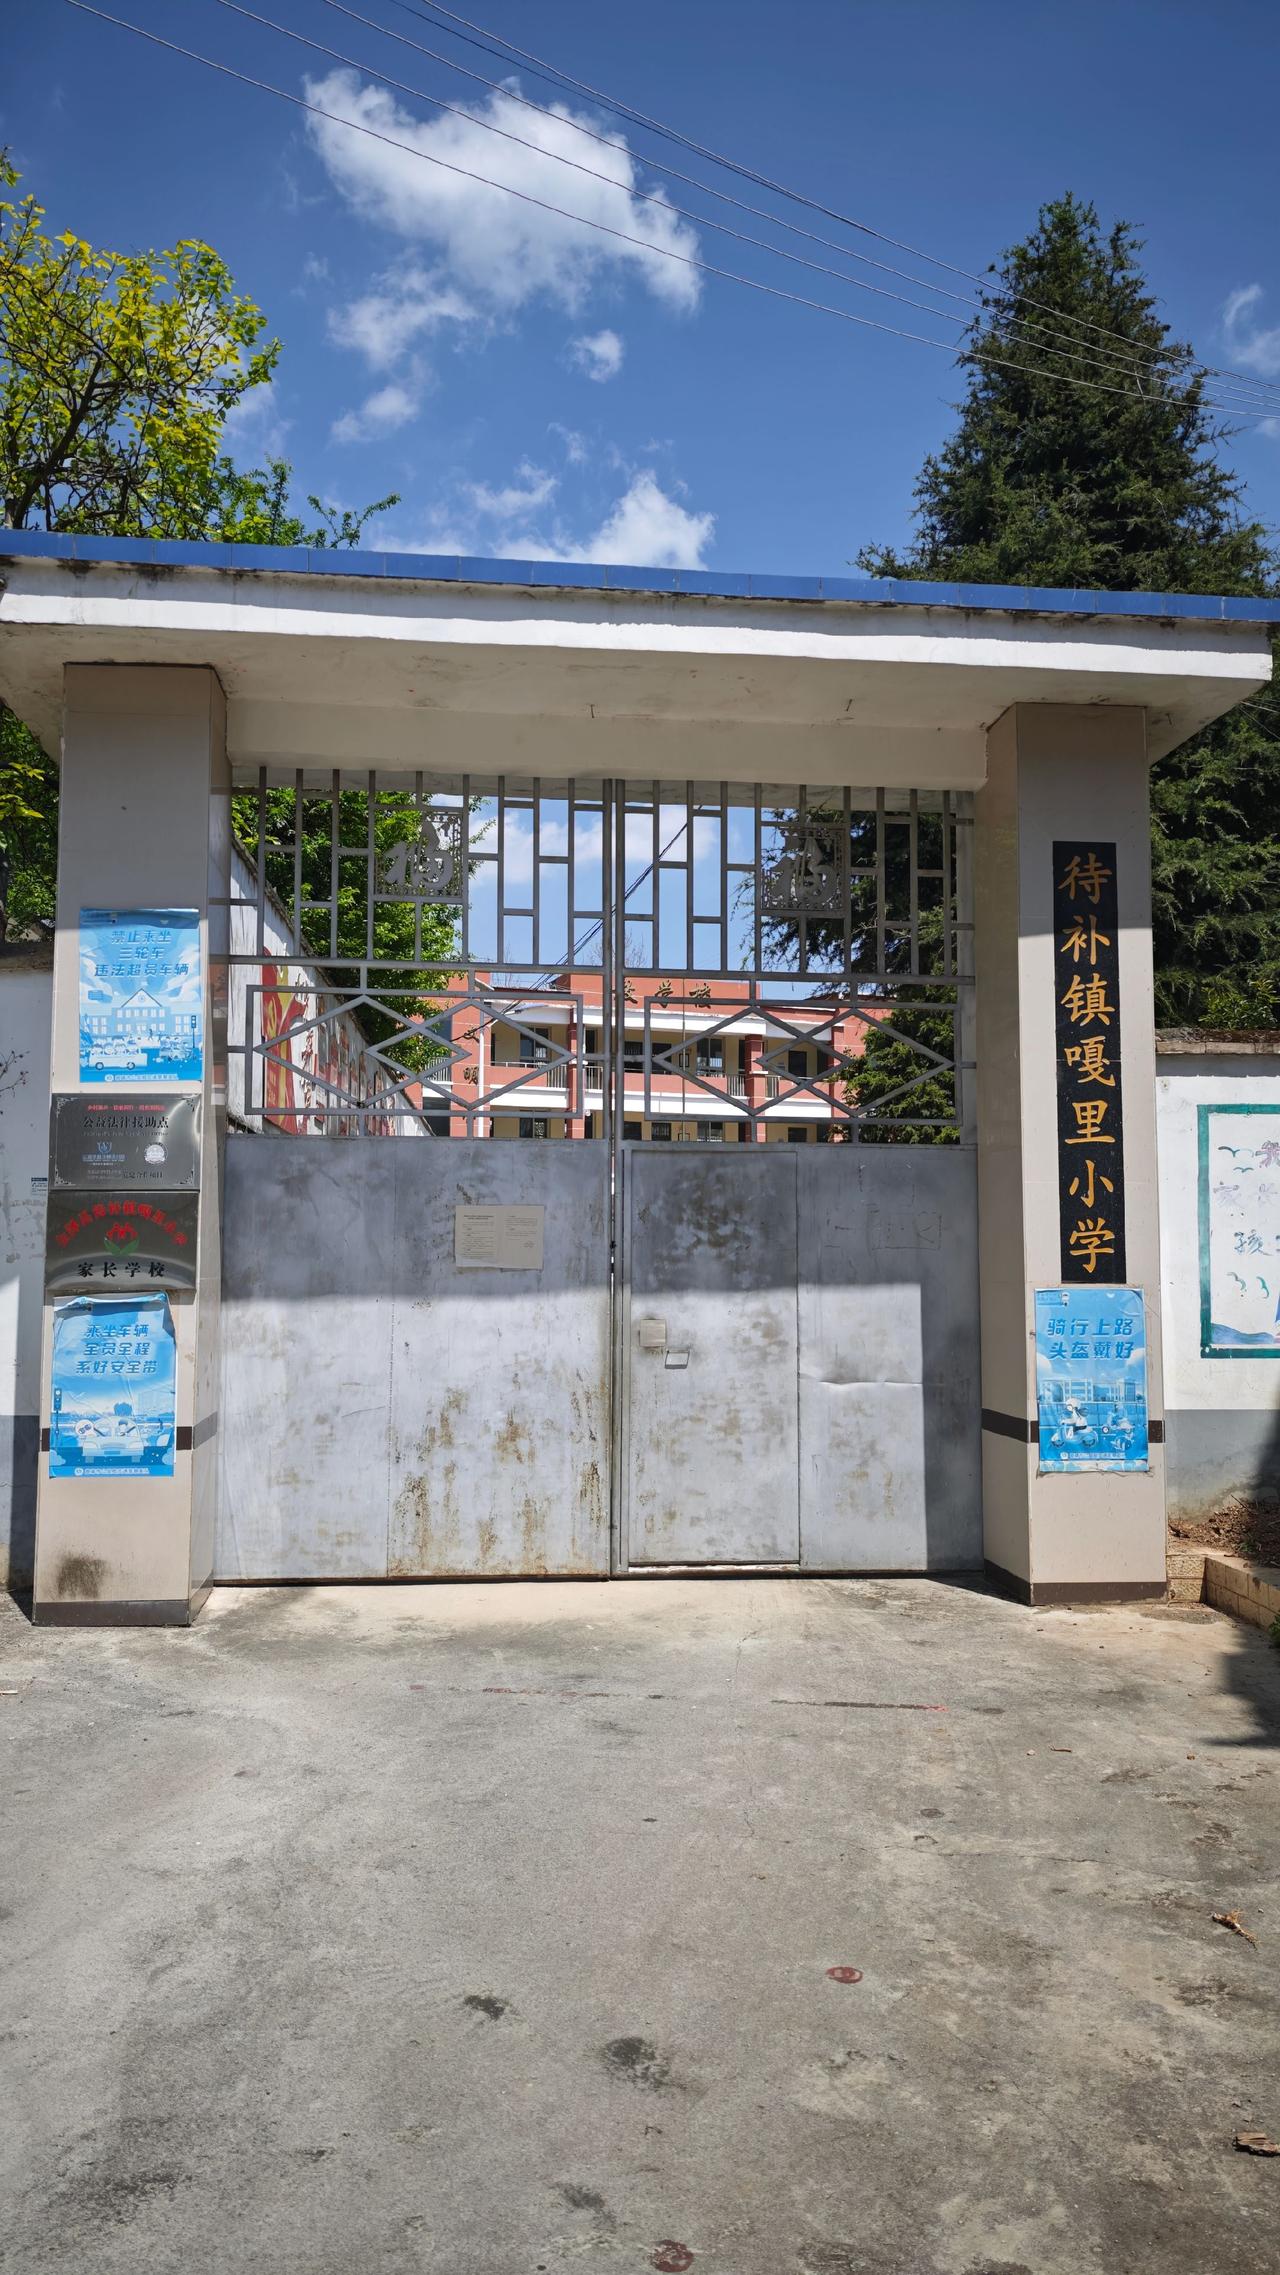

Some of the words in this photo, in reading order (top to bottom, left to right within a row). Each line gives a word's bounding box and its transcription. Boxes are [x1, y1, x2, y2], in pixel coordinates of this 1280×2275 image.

[119, 947, 165, 960] 三轮车
[94, 963, 189, 978] 违法超员车辆
[1058, 852, 1116, 1274] 待补镇嘎里小学
[83, 1115, 169, 1129] 公益法律援助点
[77, 1261, 166, 1278] 家长学校
[84, 1324, 150, 1338] 乘坐车辆
[1047, 1318, 1134, 1336] 骑行上路
[84, 1342, 150, 1356] 全员全程
[1049, 1341, 1134, 1360] 头盔戴好
[76, 1360, 158, 1374] 系好安全带
